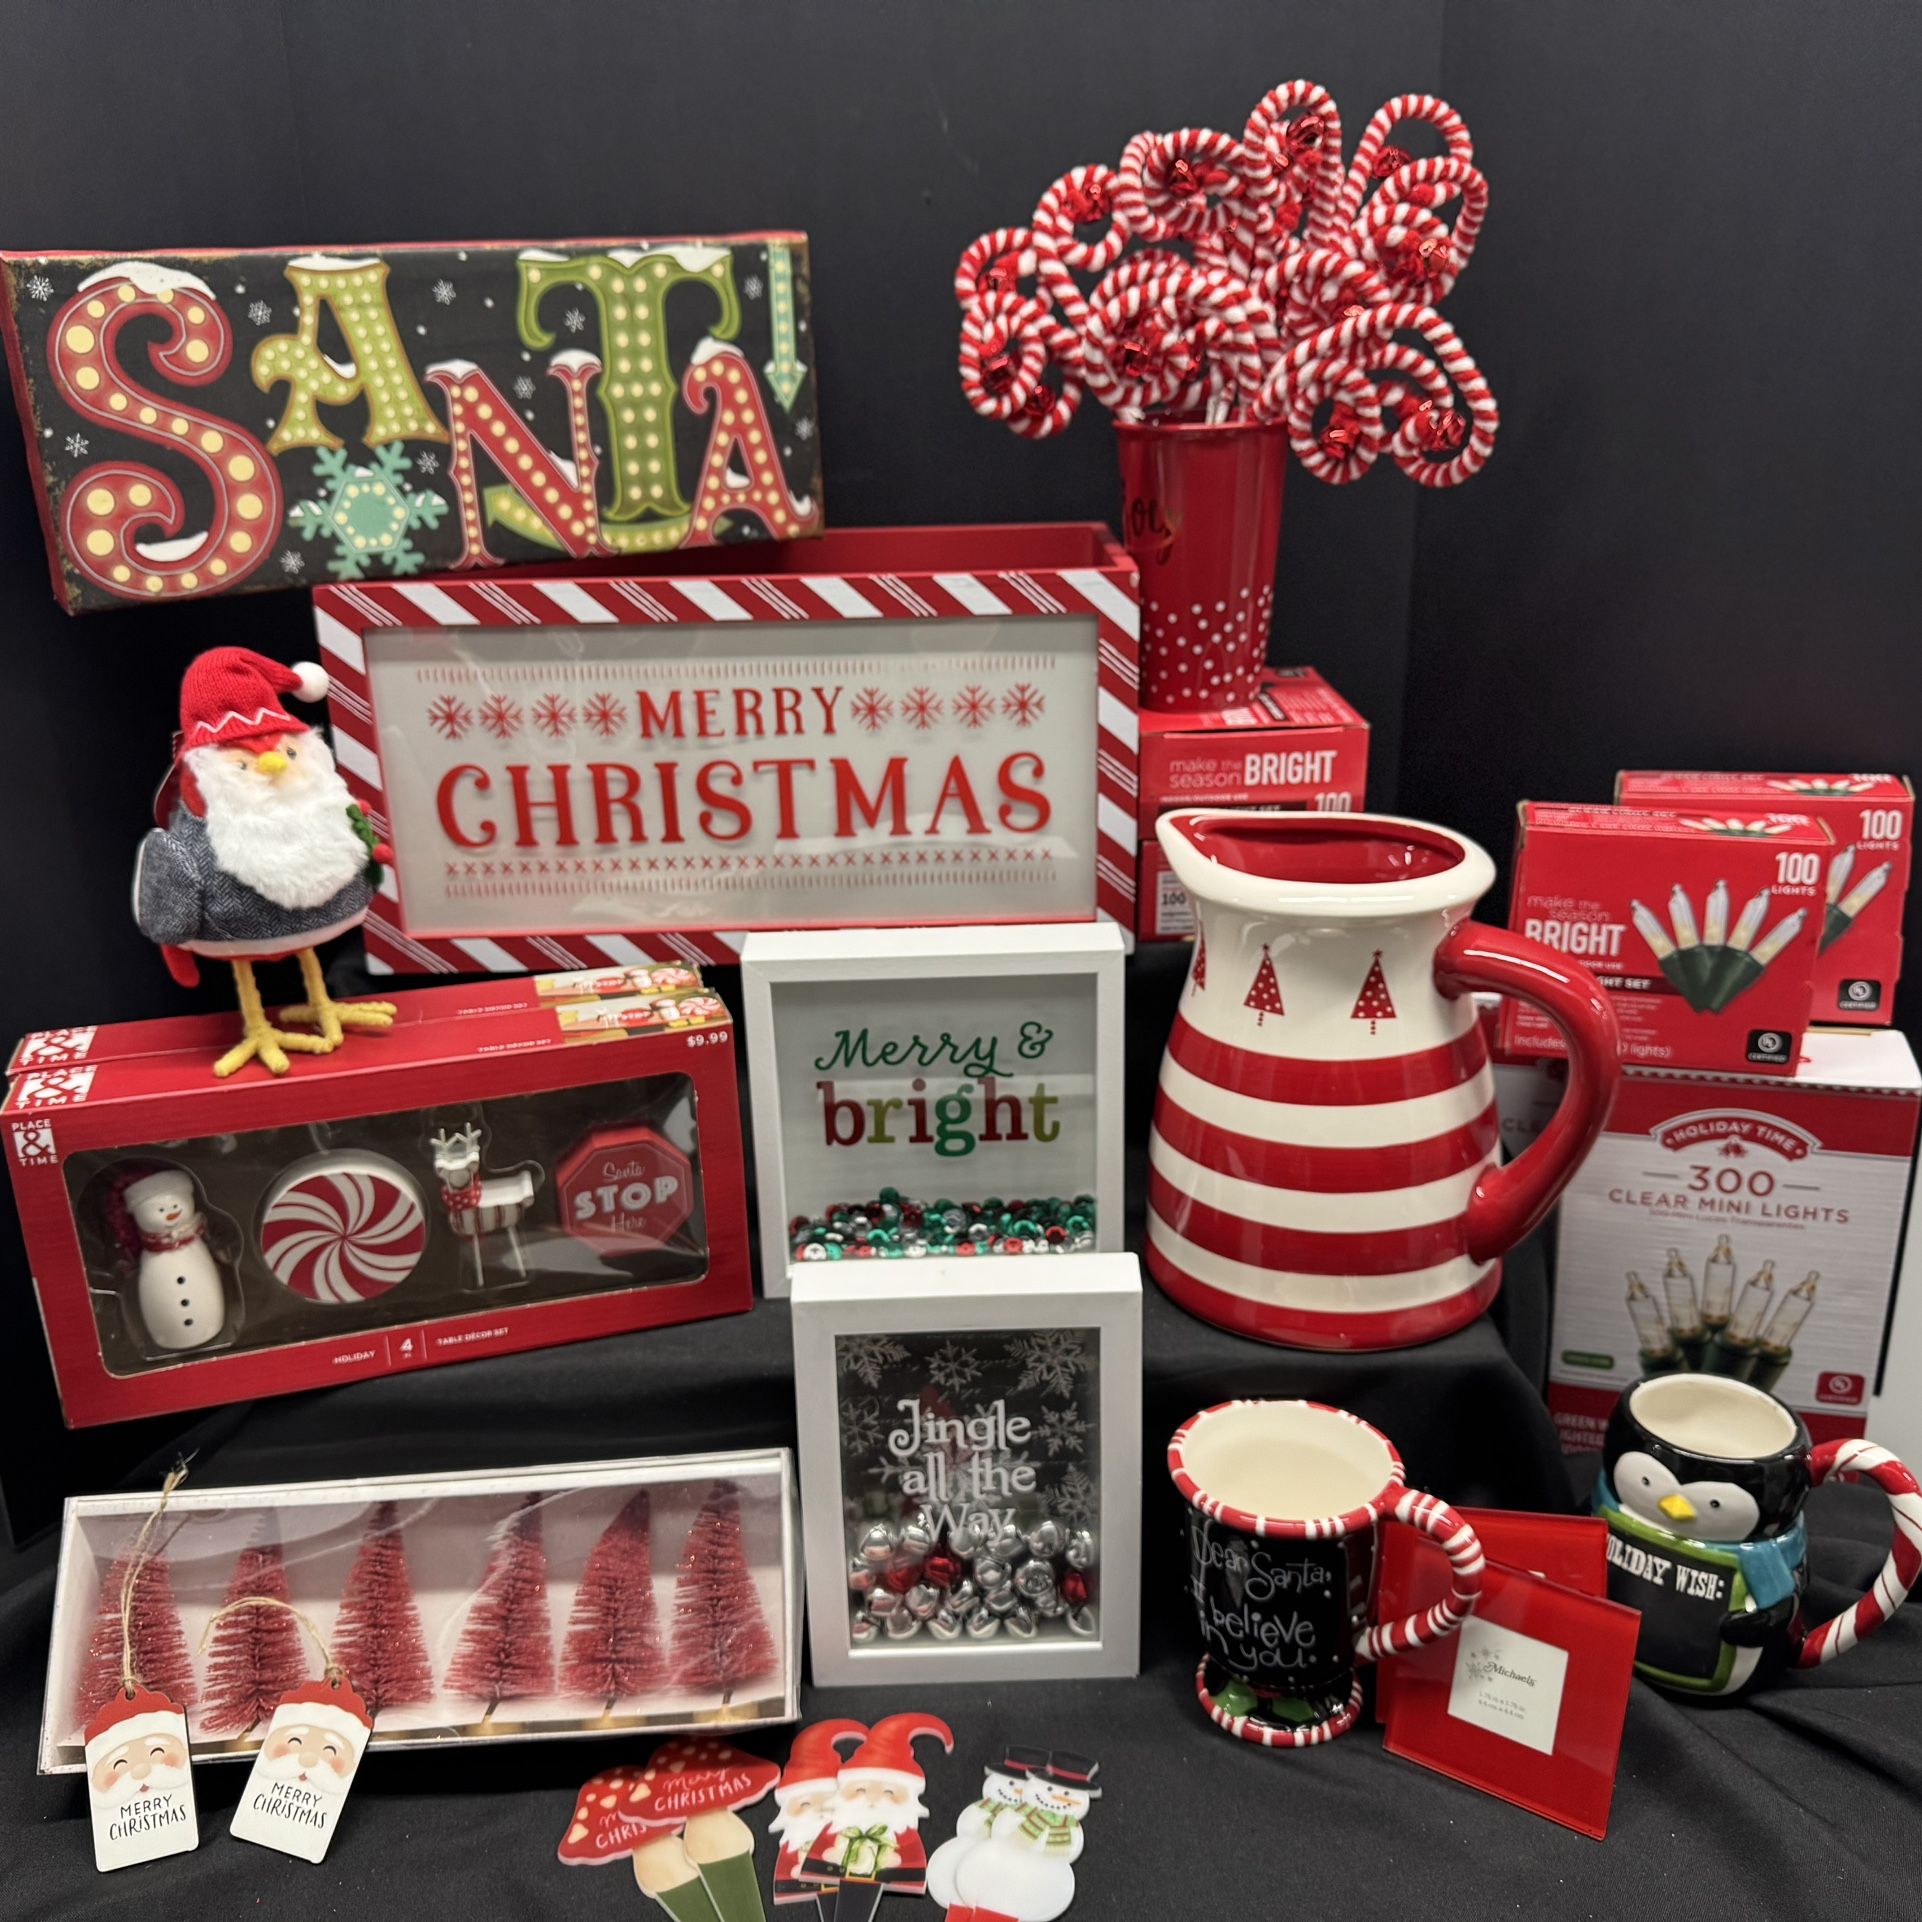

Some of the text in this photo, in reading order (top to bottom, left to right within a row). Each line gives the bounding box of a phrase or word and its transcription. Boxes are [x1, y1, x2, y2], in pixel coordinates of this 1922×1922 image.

[48, 246, 818, 598] SANTA
[635, 685, 845, 740] MERRY
[1169, 756, 1218, 773] make
[1169, 771, 1241, 789] season
[1244, 750, 1338, 786] BRIGHT
[435, 751, 1053, 848] CHRISTMAS
[1314, 792, 1352, 812] 100
[1858, 808, 1902, 840] 100
[1855, 840, 1900, 851] LIGHTS
[1774, 852, 1821, 886] 100
[1526, 894, 1574, 909] make
[1769, 885, 1817, 896] LIGHTS
[1550, 909, 1610, 922] season
[1524, 918, 1627, 957] BRIGHT
[686, 1031, 729, 1048] $9.99
[813, 1021, 1054, 1079] Merry &
[11, 1118, 52, 1132] PLACE
[816, 1076, 1061, 1157] bright
[1673, 1120, 1797, 1151] HOLIDAY TIME
[19, 1154, 59, 1167] TIME
[603, 1160, 646, 1182] Santa
[1686, 1164, 1776, 1197] 300
[574, 1175, 680, 1220] STOP
[1608, 1188, 1689, 1208] CLEAR
[1697, 1196, 1751, 1216] MINI
[1760, 1200, 1851, 1224] LIGHTS
[610, 1211, 647, 1233] Here
[333, 1350, 376, 1365] HOLIDAY
[400, 1337, 414, 1352] 4
[887, 1399, 1032, 1457] Jingle
[902, 1451, 1037, 1502] all the
[919, 1503, 1018, 1545] Way
[1190, 1519, 1248, 1573] Dear
[1607, 1532, 1725, 1601] OLIDAY WISH:
[1210, 1595, 1316, 1648] believe
[1483, 1661, 1536, 1687] Michaels
[119, 1793, 174, 1820] MERRY
[270, 1781, 323, 1807] MERRY
[654, 1772, 752, 1812] CHRISTMAS
[108, 1805, 187, 1842] CHRISTMAS
[252, 1793, 328, 1830] CHRISTMAS
[596, 1823, 648, 1849] CHRIS
